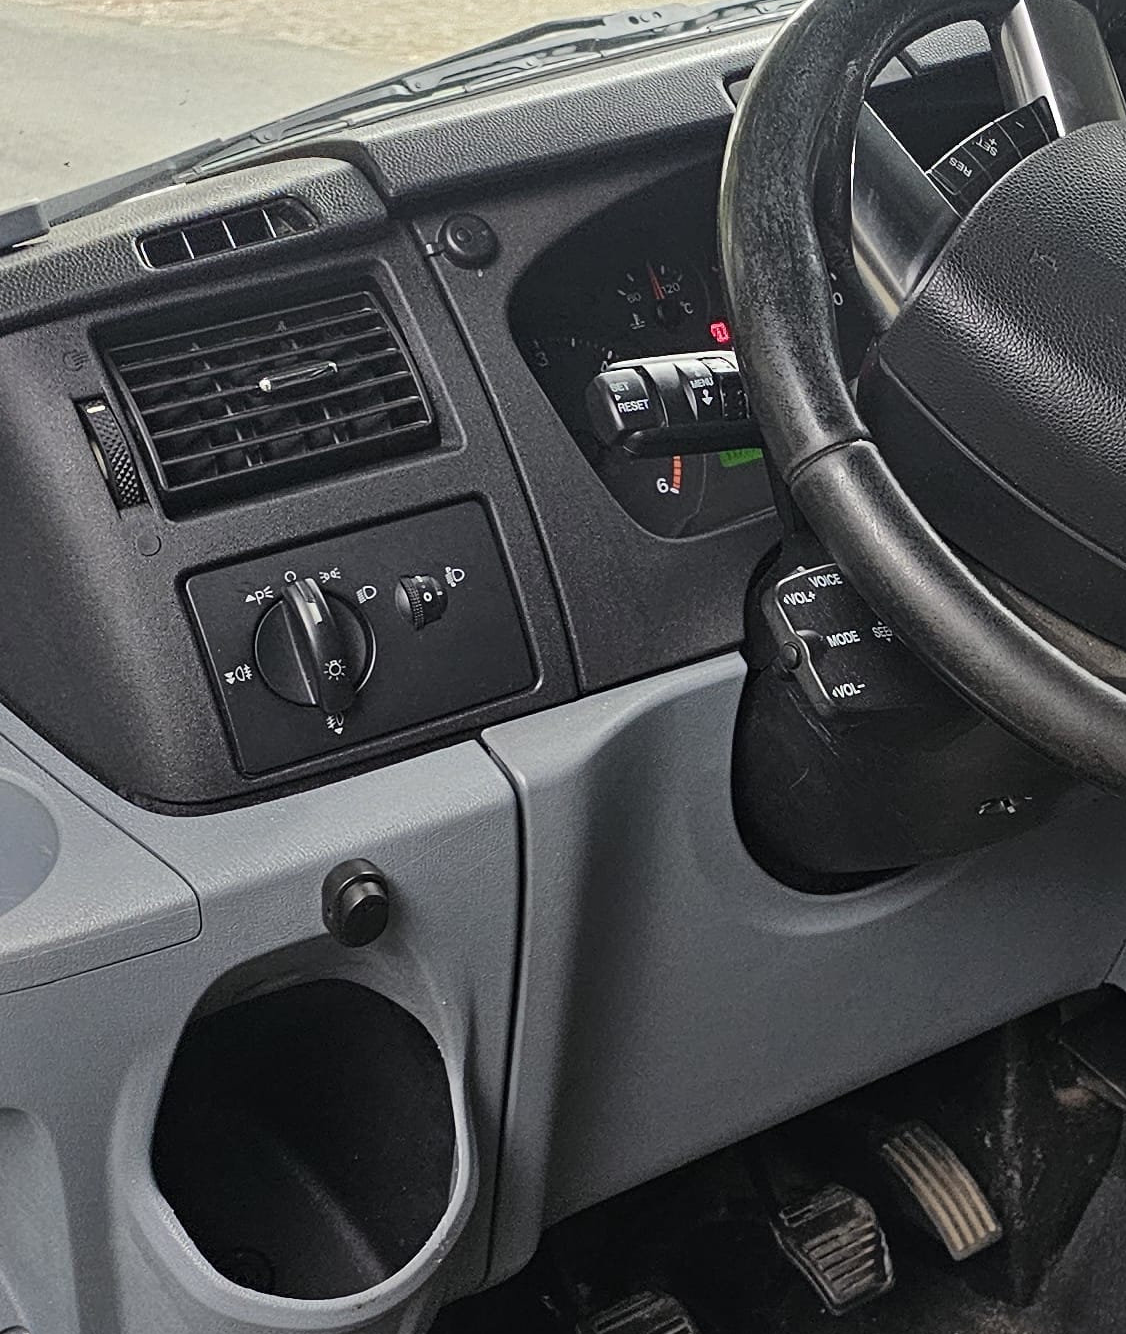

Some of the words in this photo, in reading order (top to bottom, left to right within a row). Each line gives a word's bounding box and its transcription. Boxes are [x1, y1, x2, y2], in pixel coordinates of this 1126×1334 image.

[976, 134, 998, 157] SET
[948, 157, 973, 178] RES
[609, 381, 630, 392] SET
[690, 377, 714, 389] MENU
[617, 398, 650, 413] RESET
[656, 478, 669, 493] 6
[808, 573, 844, 588] VOICE
[826, 630, 861, 647] MODE
